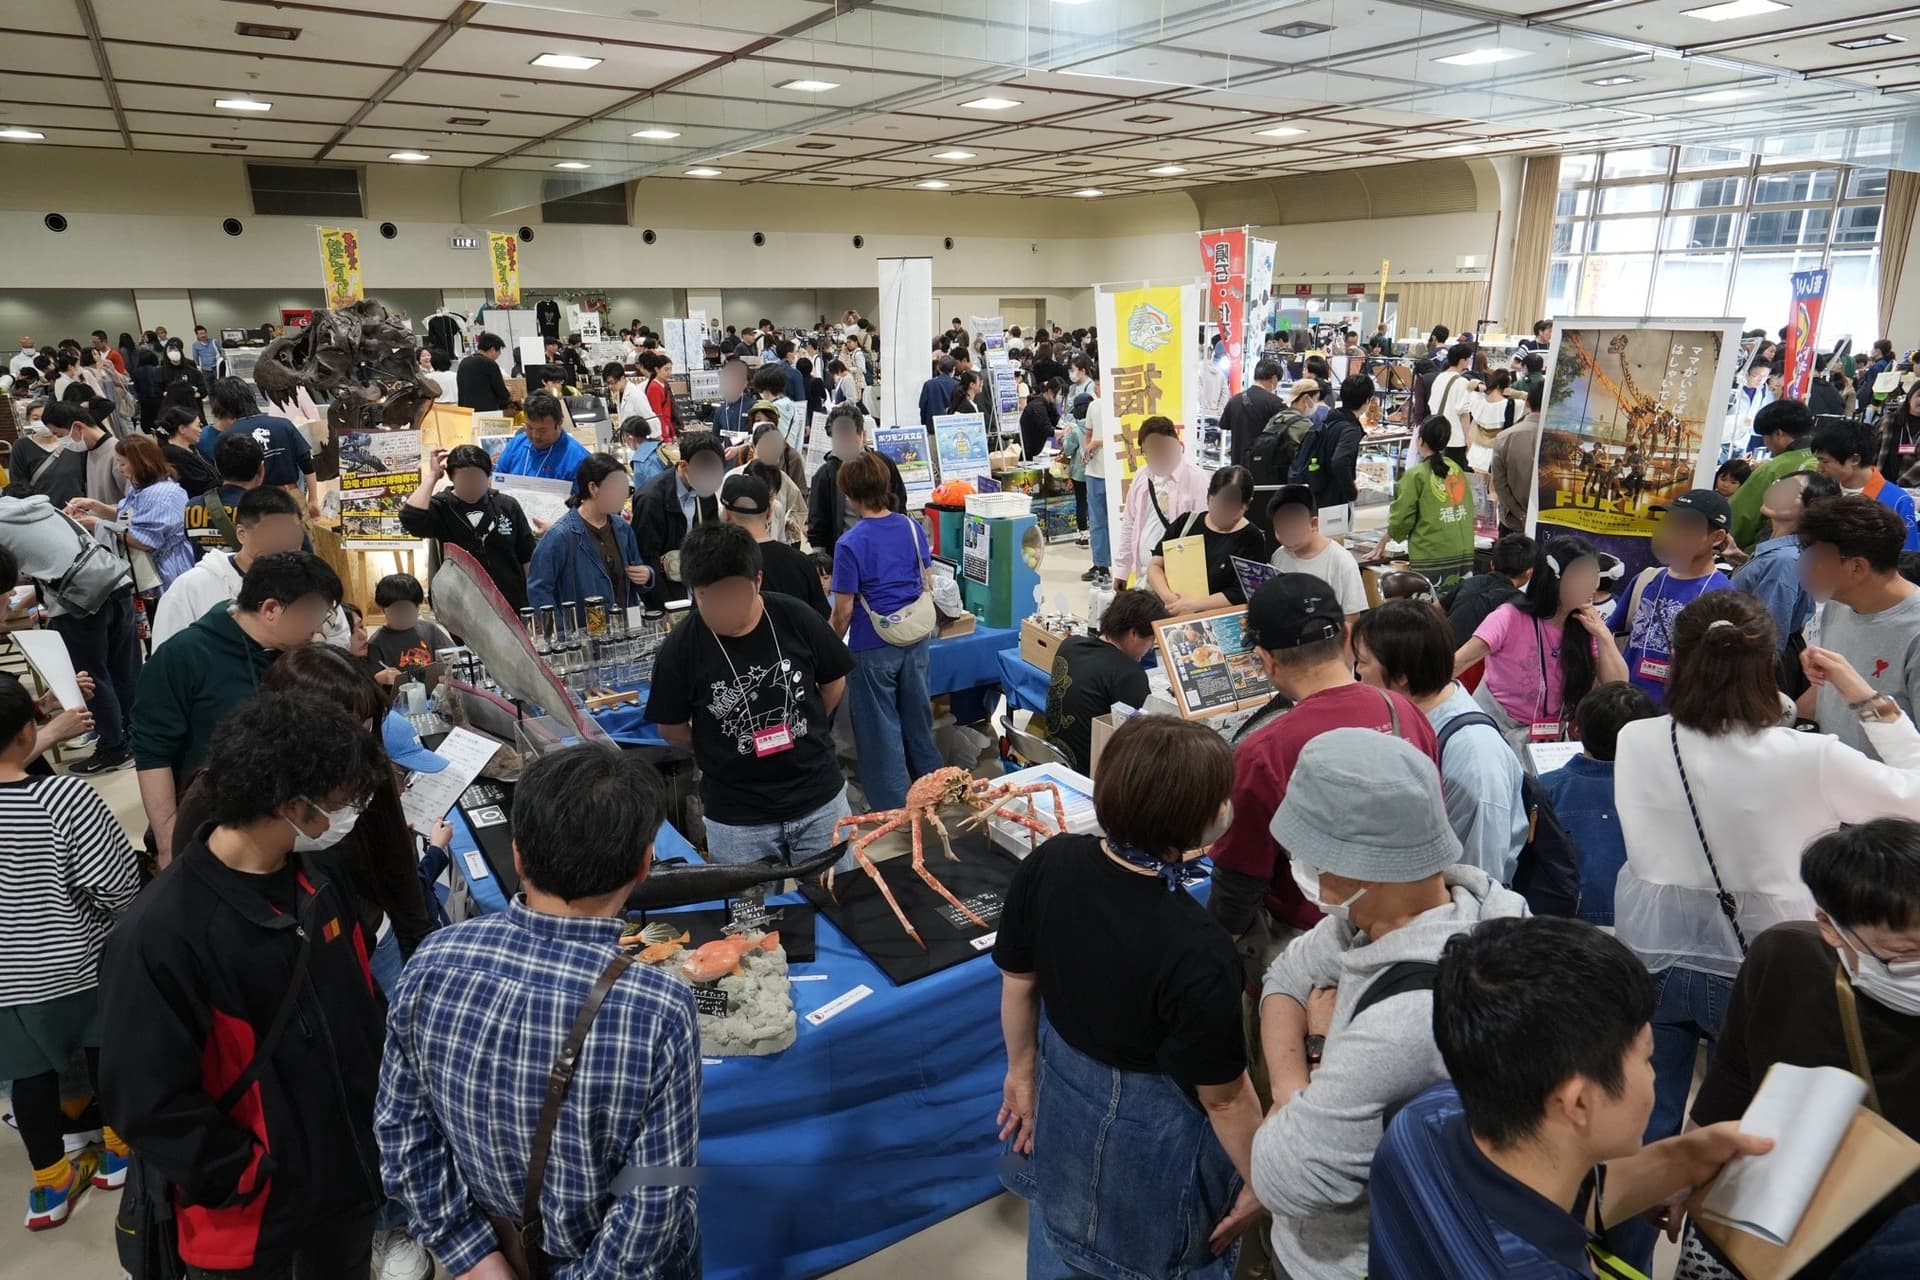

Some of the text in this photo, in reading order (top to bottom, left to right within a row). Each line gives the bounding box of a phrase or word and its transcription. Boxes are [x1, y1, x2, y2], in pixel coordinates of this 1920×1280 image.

[1668, 346, 1703, 427] ママがいちばん
